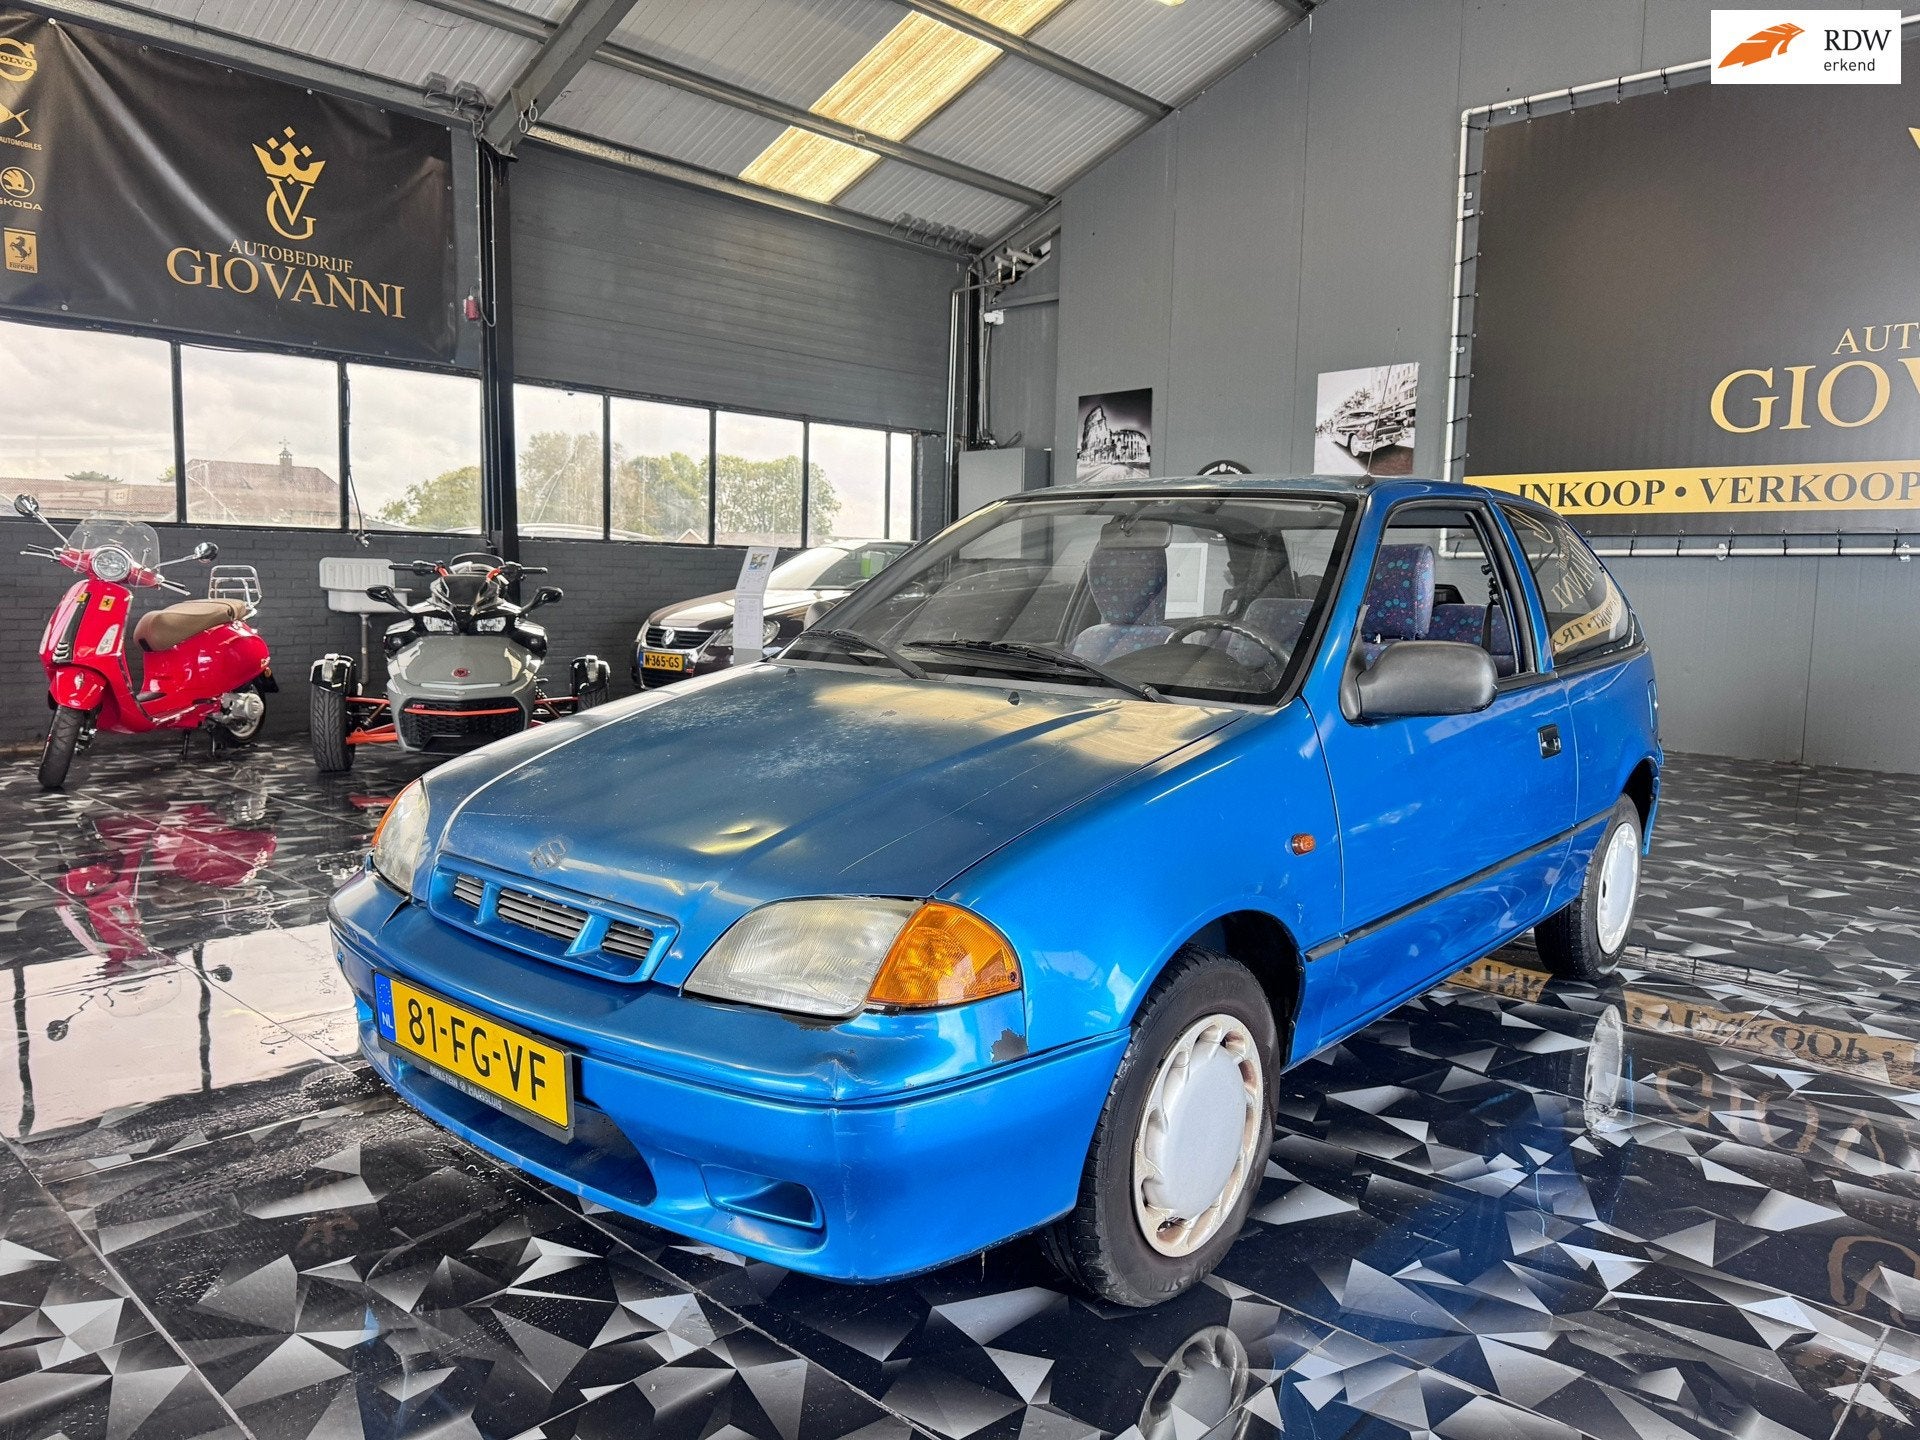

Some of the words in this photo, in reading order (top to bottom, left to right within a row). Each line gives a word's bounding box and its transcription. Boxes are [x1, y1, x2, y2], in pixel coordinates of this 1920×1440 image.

[0, 54, 32, 68] OLVO
[229, 238, 353, 274] AUTOBEDRIJF
[166, 246, 406, 319] GIOVANNI
[1831, 322, 1920, 355] AUT
[1699, 470, 1920, 505] VERKOOP
[381, 1011, 394, 1030] NL
[407, 998, 546, 1102] 81-FG-VF
